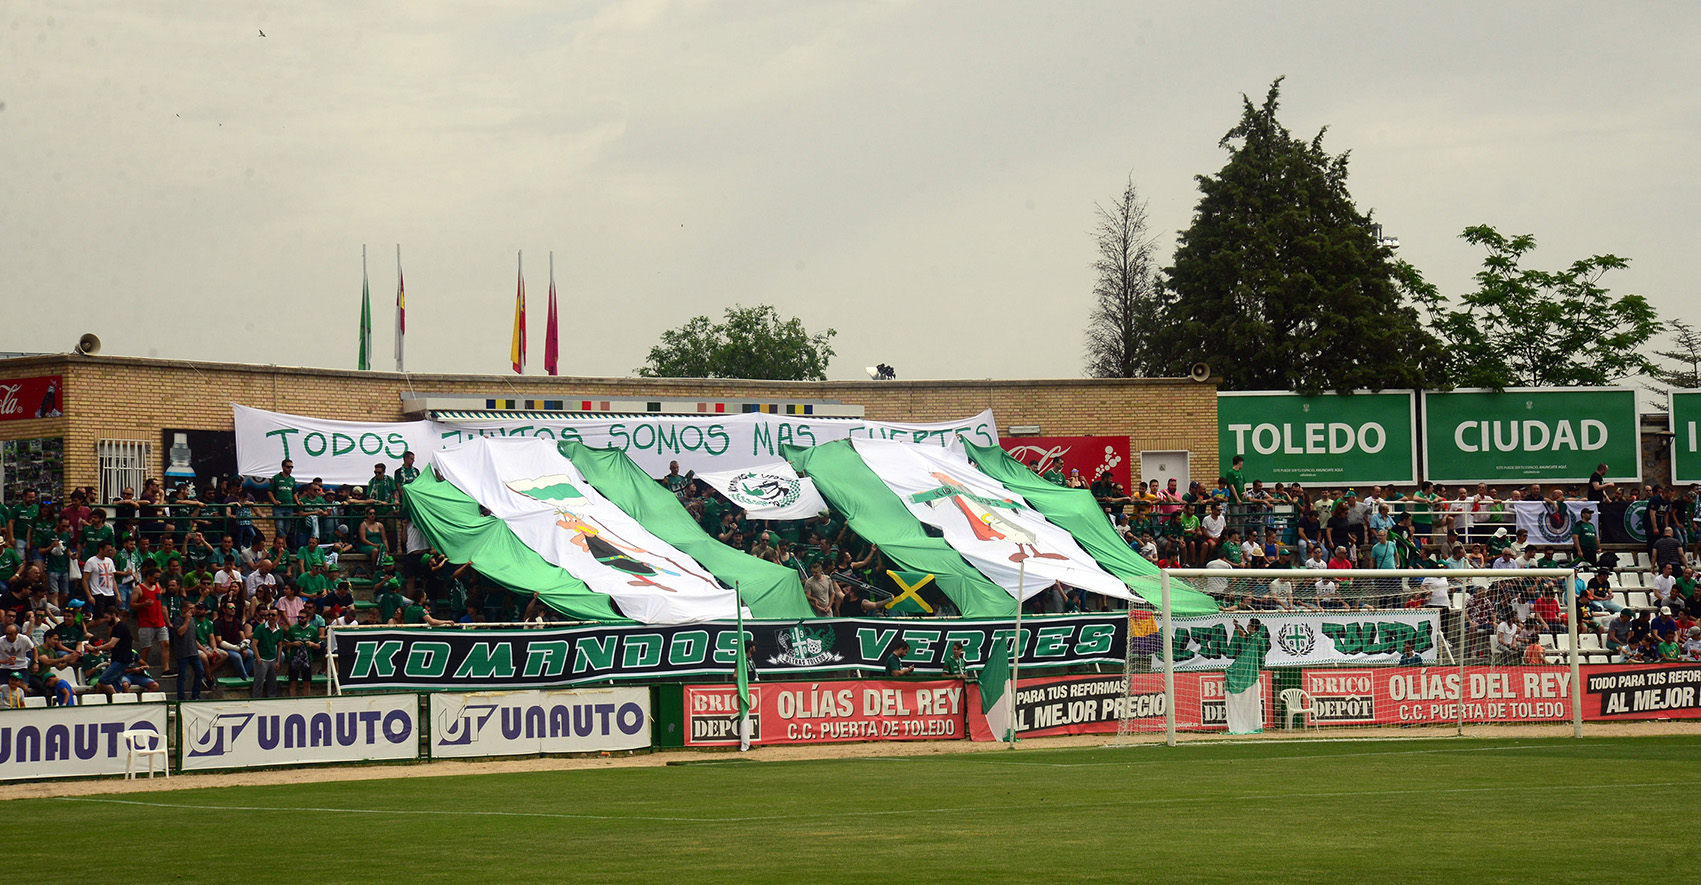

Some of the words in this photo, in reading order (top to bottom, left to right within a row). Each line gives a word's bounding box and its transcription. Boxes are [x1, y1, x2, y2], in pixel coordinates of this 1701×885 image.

[266, 428, 409, 461] TODOS
[608, 423, 731, 457] SOMOS
[753, 422, 816, 457] MAS
[1228, 421, 1387, 455] TOLEDO
[1454, 419, 1608, 452] CIUDAD
[349, 629, 756, 679] KOMANDOS
[856, 624, 1116, 664] VERDES
[1016, 688, 1046, 705] PARA
[1047, 685, 1068, 700] TUS
[1070, 679, 1129, 698] REFORMAS
[1311, 676, 1371, 693] BRICO
[1388, 668, 1461, 701] OLÍAS
[1470, 673, 1517, 700] DEL
[1523, 672, 1572, 699] REY
[1590, 676, 1617, 690] TODO
[1618, 674, 1646, 688] PARA
[1647, 672, 1667, 686] TUS
[1668, 669, 1701, 684] REFOR
[777, 683, 854, 720] OLÍAS
[863, 688, 912, 717] DEL
[916, 687, 963, 715] REY
[1034, 700, 1098, 729] MEJOR
[1101, 693, 1167, 721] PRECIO
[1399, 704, 1428, 721] C.C.
[1430, 703, 1485, 720] PUERTA
[1488, 702, 1507, 719] DE
[1510, 701, 1565, 719] TOLEDO
[1606, 692, 1630, 714] AL
[1633, 686, 1695, 712] MEJOR
[788, 723, 817, 740] C.C.
[820, 721, 879, 739] PUERTA
[881, 720, 900, 737] DE
[904, 718, 955, 737] TOLEDO
